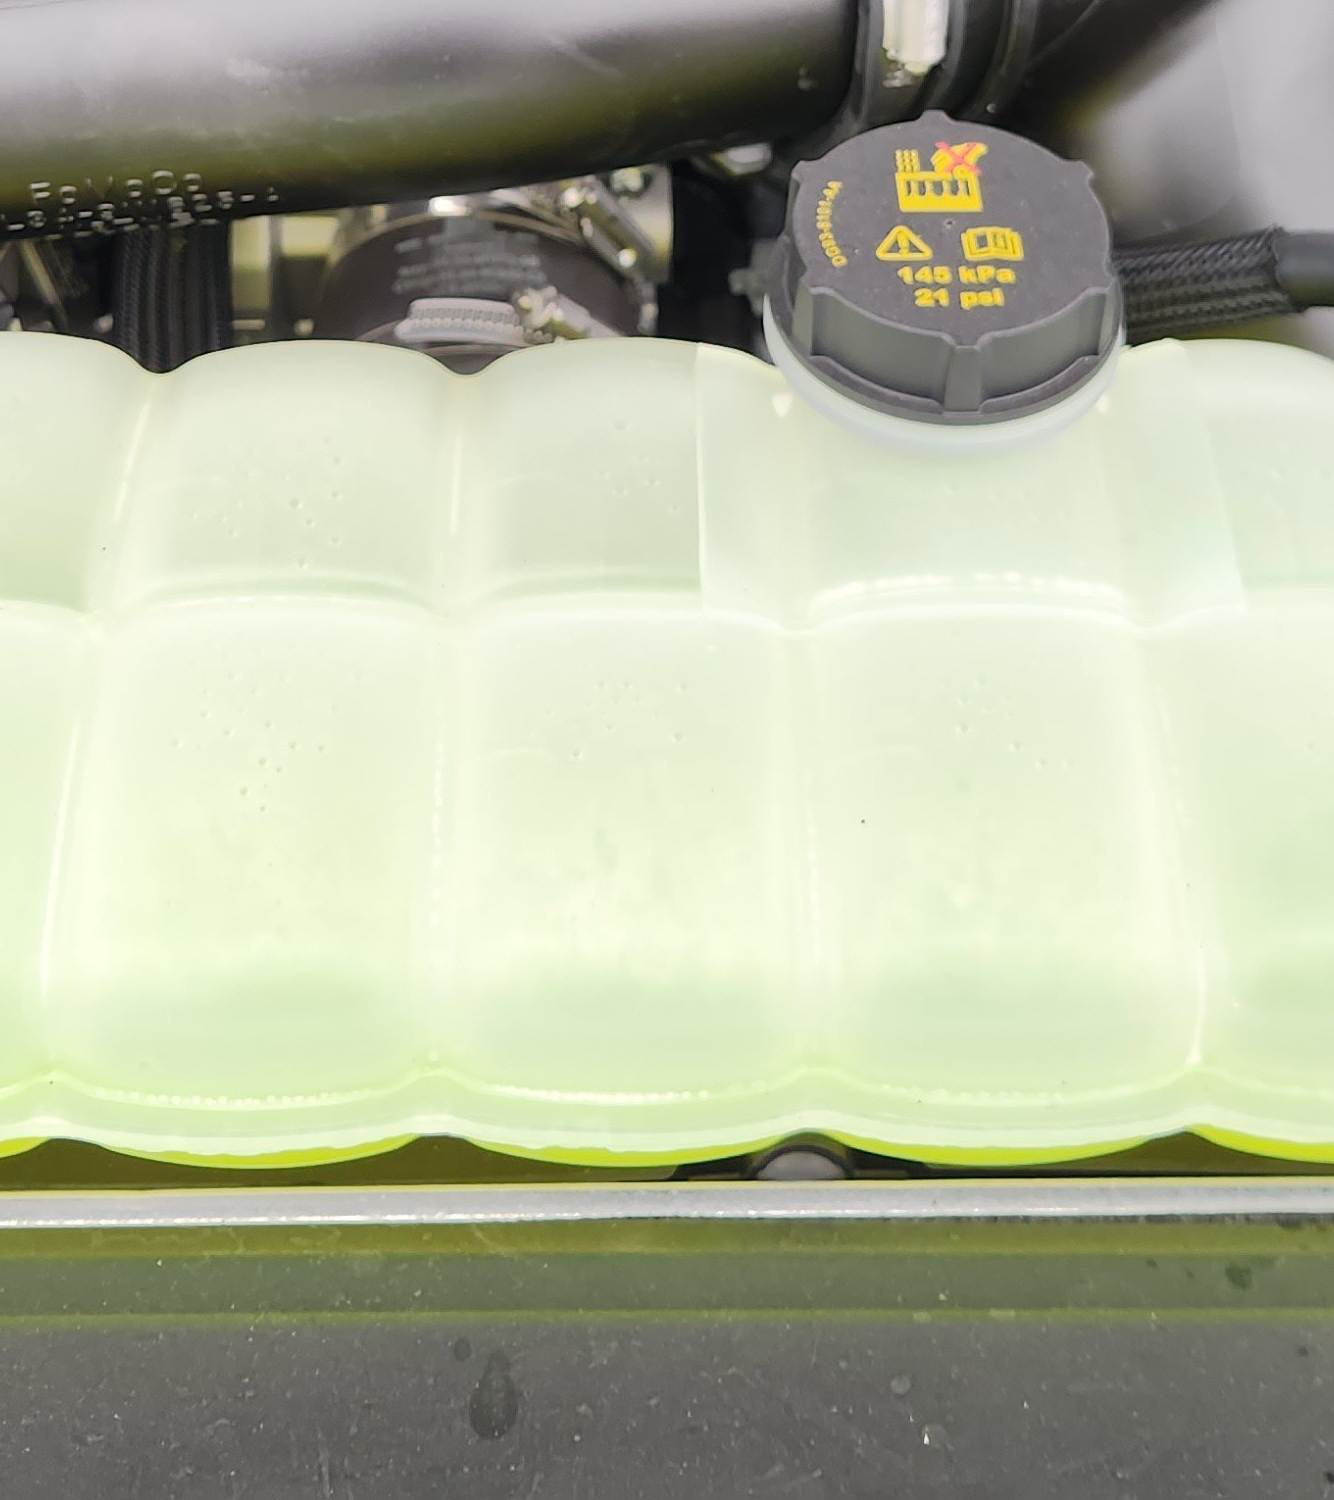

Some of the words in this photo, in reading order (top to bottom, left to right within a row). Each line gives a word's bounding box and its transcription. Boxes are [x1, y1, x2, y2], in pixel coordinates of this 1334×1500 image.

[897, 265, 952, 284] 145
[958, 264, 1015, 285] kPa
[914, 287, 949, 308] 21
[960, 286, 1004, 311] psi
